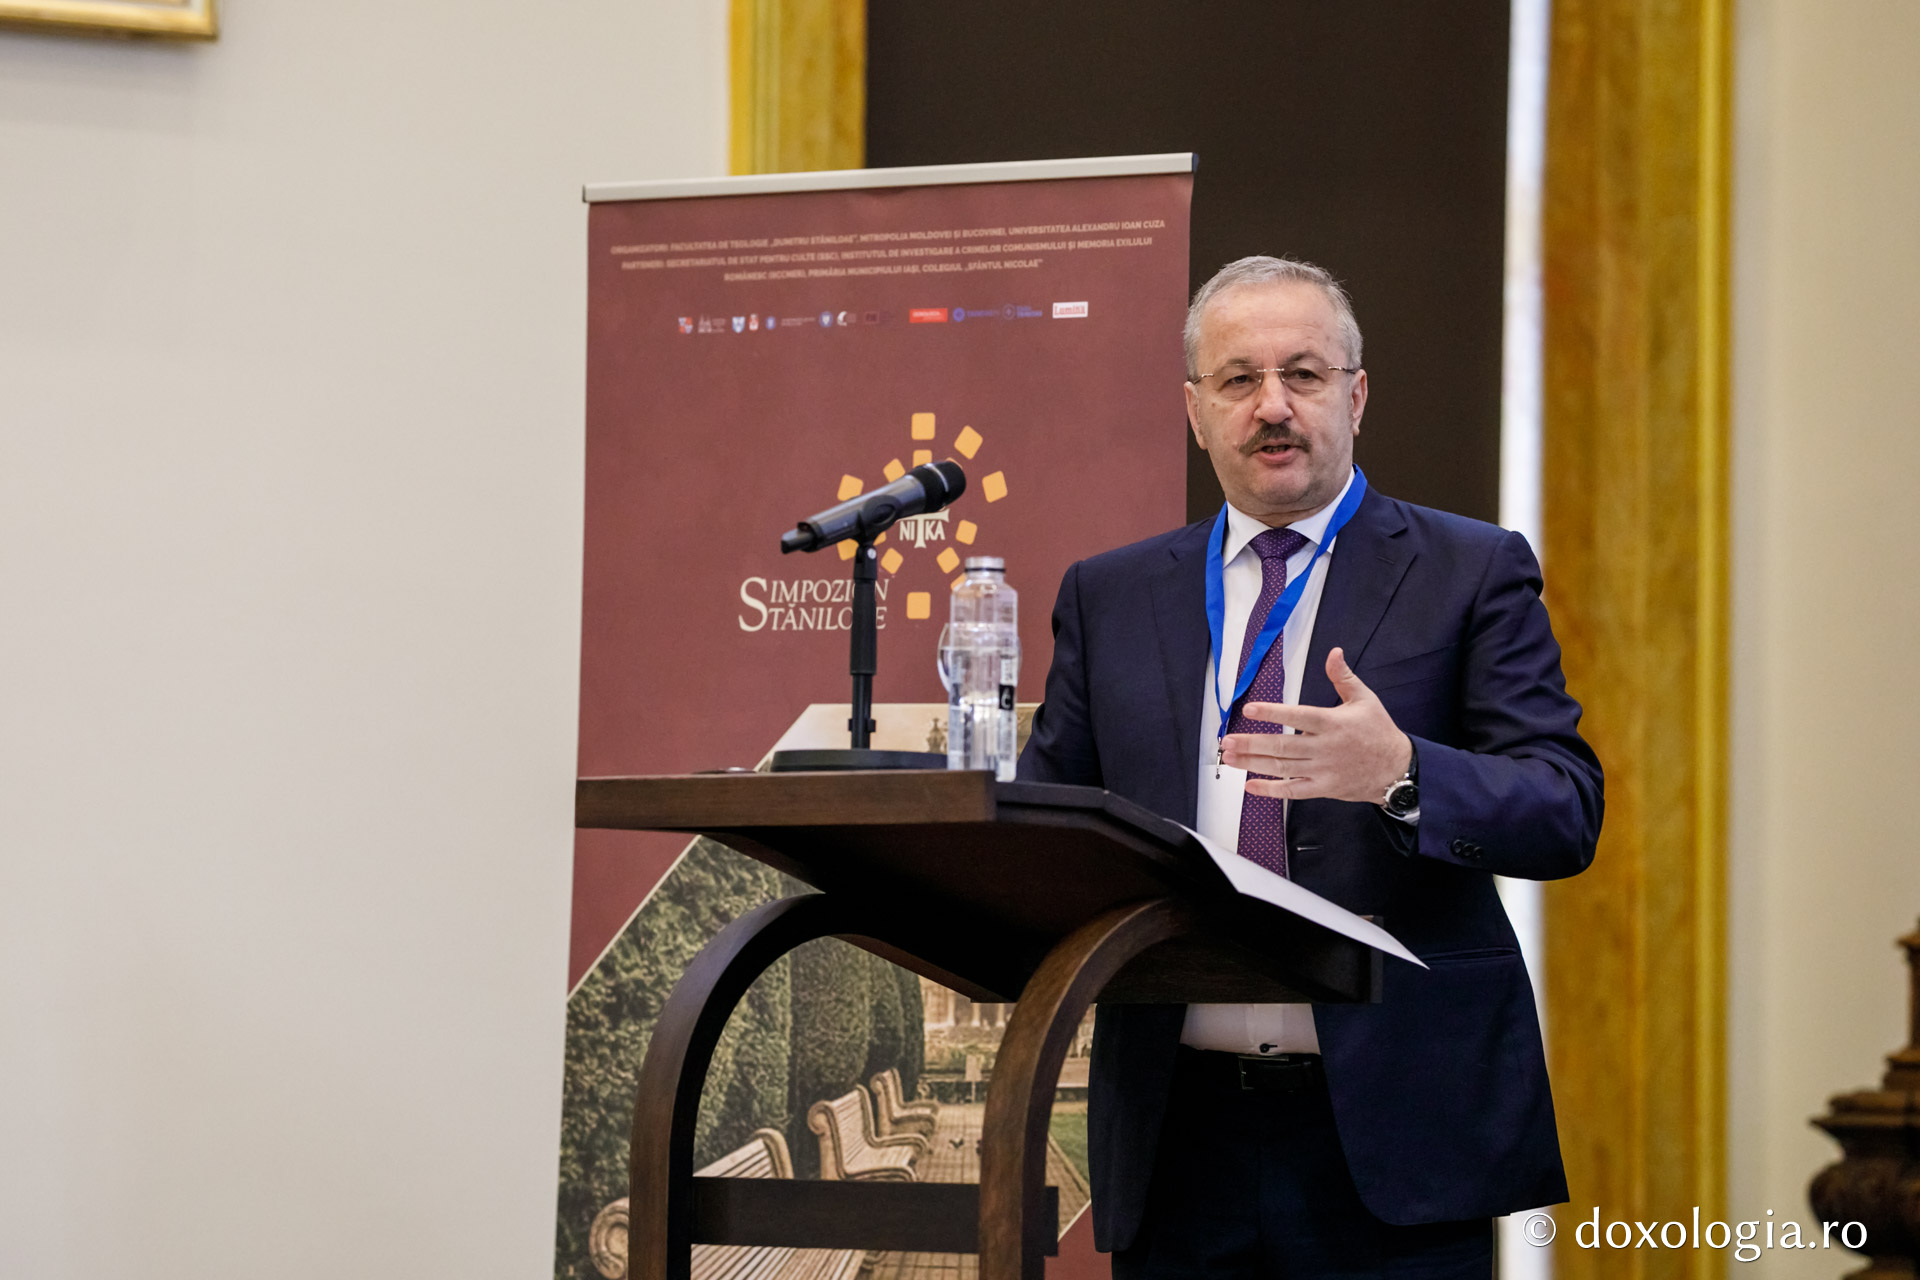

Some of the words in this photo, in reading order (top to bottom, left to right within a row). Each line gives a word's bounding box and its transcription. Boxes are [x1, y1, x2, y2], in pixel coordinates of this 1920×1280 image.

[909, 230, 952, 241] MOLDOVEI
[1008, 225, 1071, 236] UNIVERSITATEA
[1071, 222, 1120, 233] ALEXANDRU
[1121, 221, 1142, 231] IOAN
[1143, 220, 1165, 230] CUZA
[739, 255, 758, 265] STAT
[759, 254, 790, 264] PENTRU
[900, 246, 953, 257] INVESTIGARE
[961, 244, 1001, 254] CRIMELOR
[1002, 241, 1066, 252] COMUNISMULUI
[1077, 239, 1115, 249] MEMORIA
[1116, 237, 1153, 247] EXILULUI
